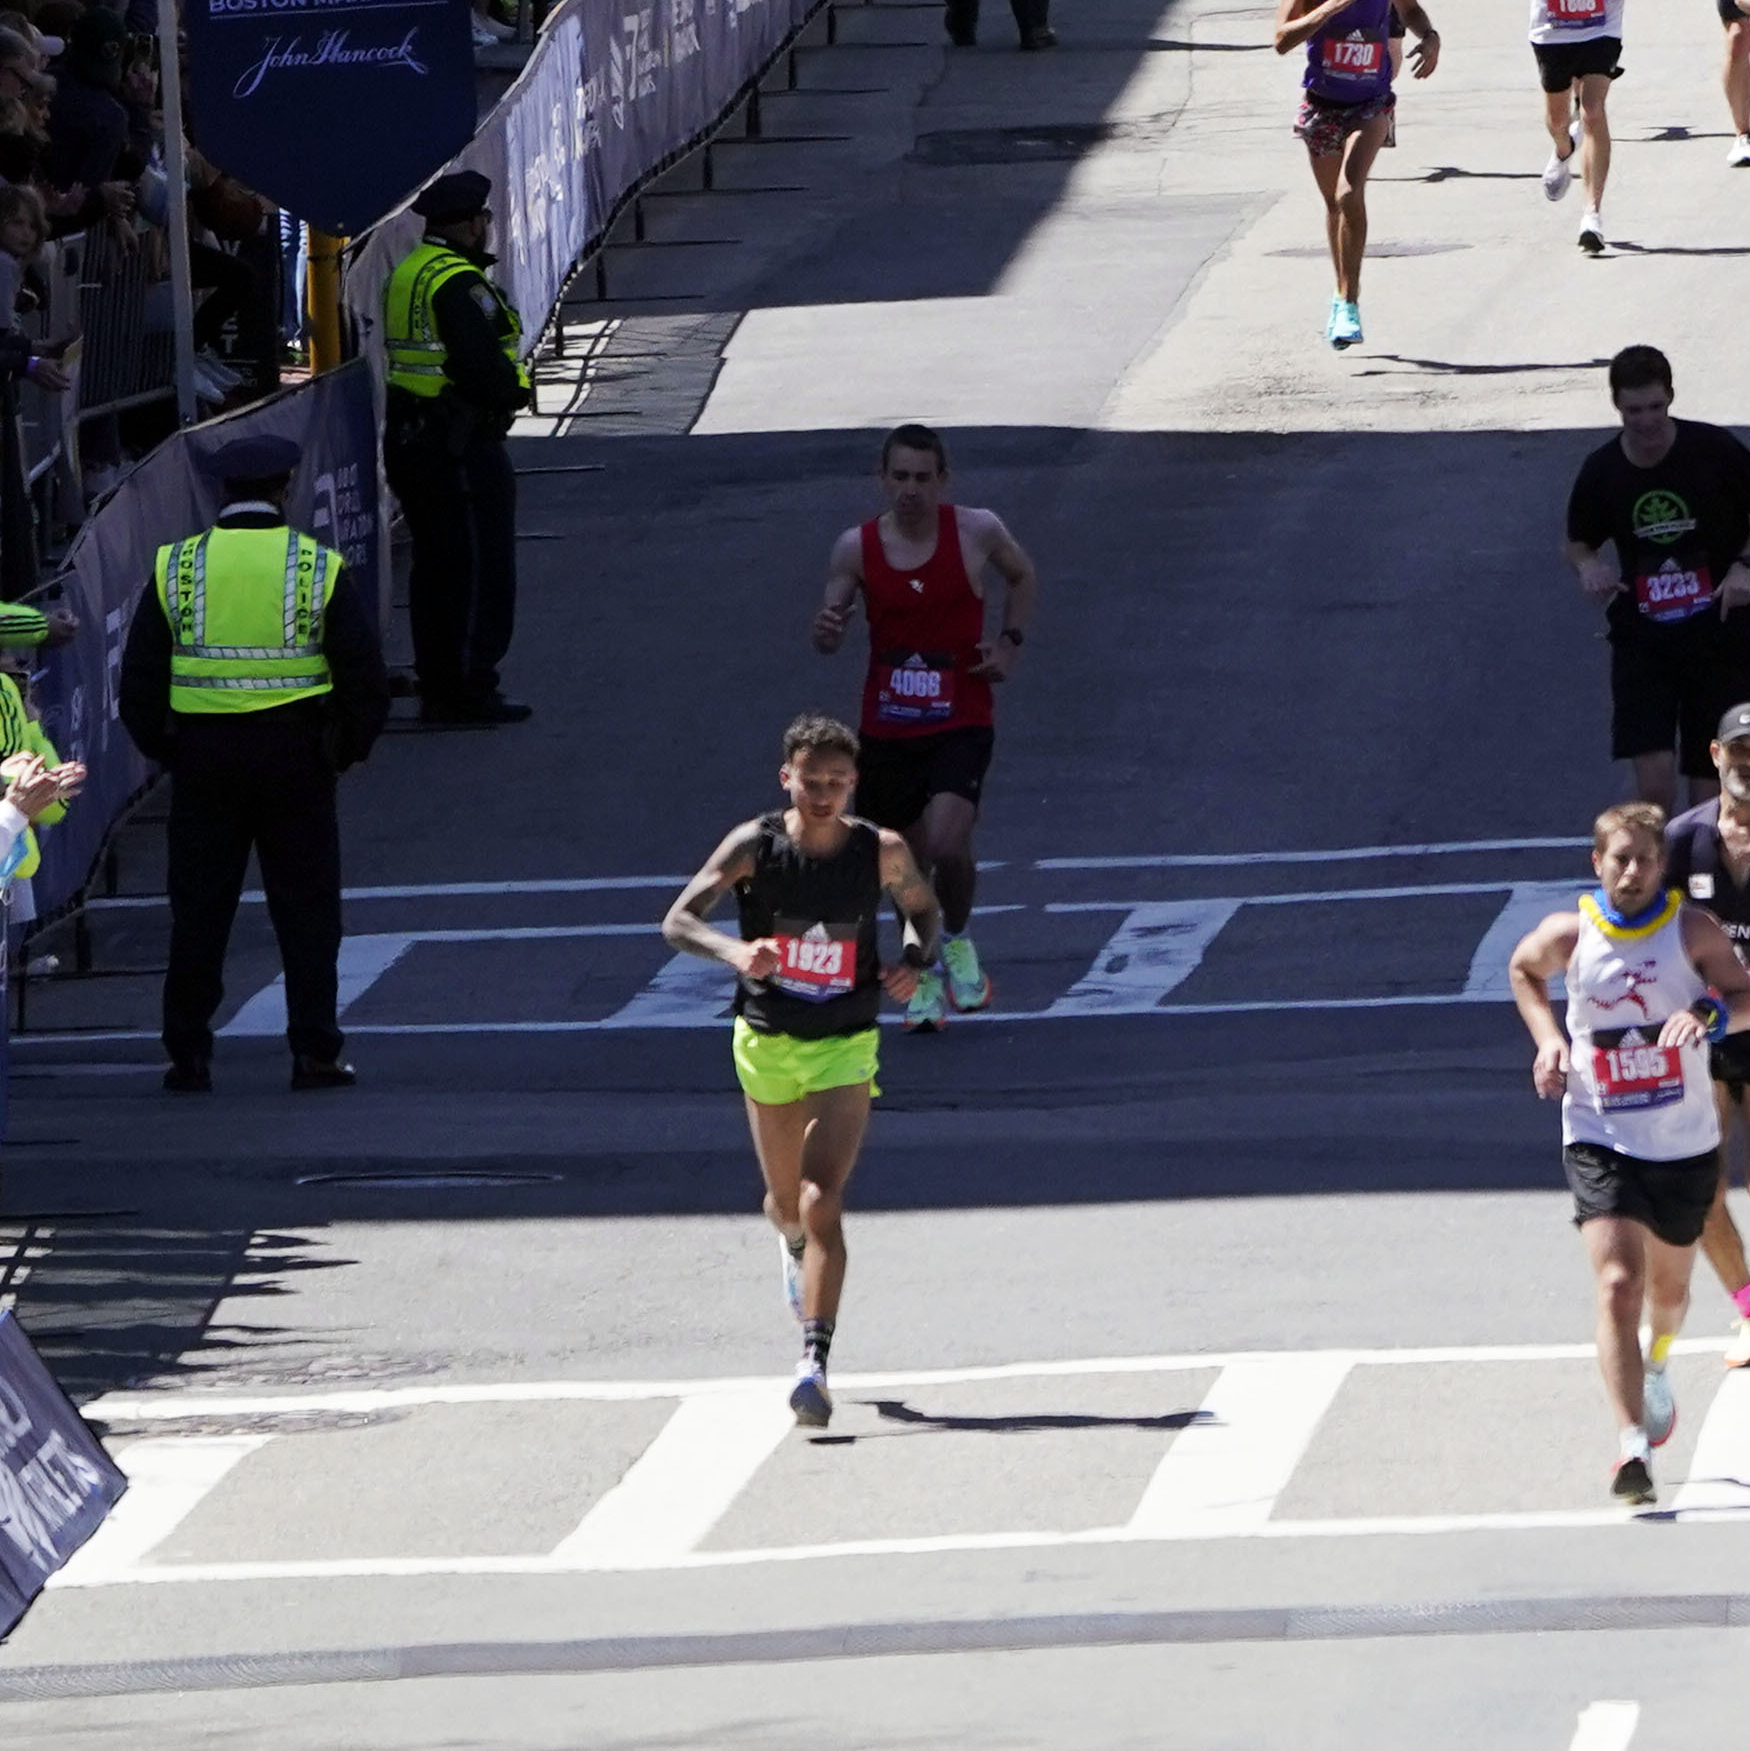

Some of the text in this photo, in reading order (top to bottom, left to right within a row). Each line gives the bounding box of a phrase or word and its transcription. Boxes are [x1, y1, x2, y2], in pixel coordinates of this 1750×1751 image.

[233, 28, 429, 100] John Hancock
[1334, 43, 1373, 67] 1730
[1647, 571, 1700, 602] 3233
[788, 938, 844, 974] 1923
[1605, 1048, 1669, 1083] 1595
